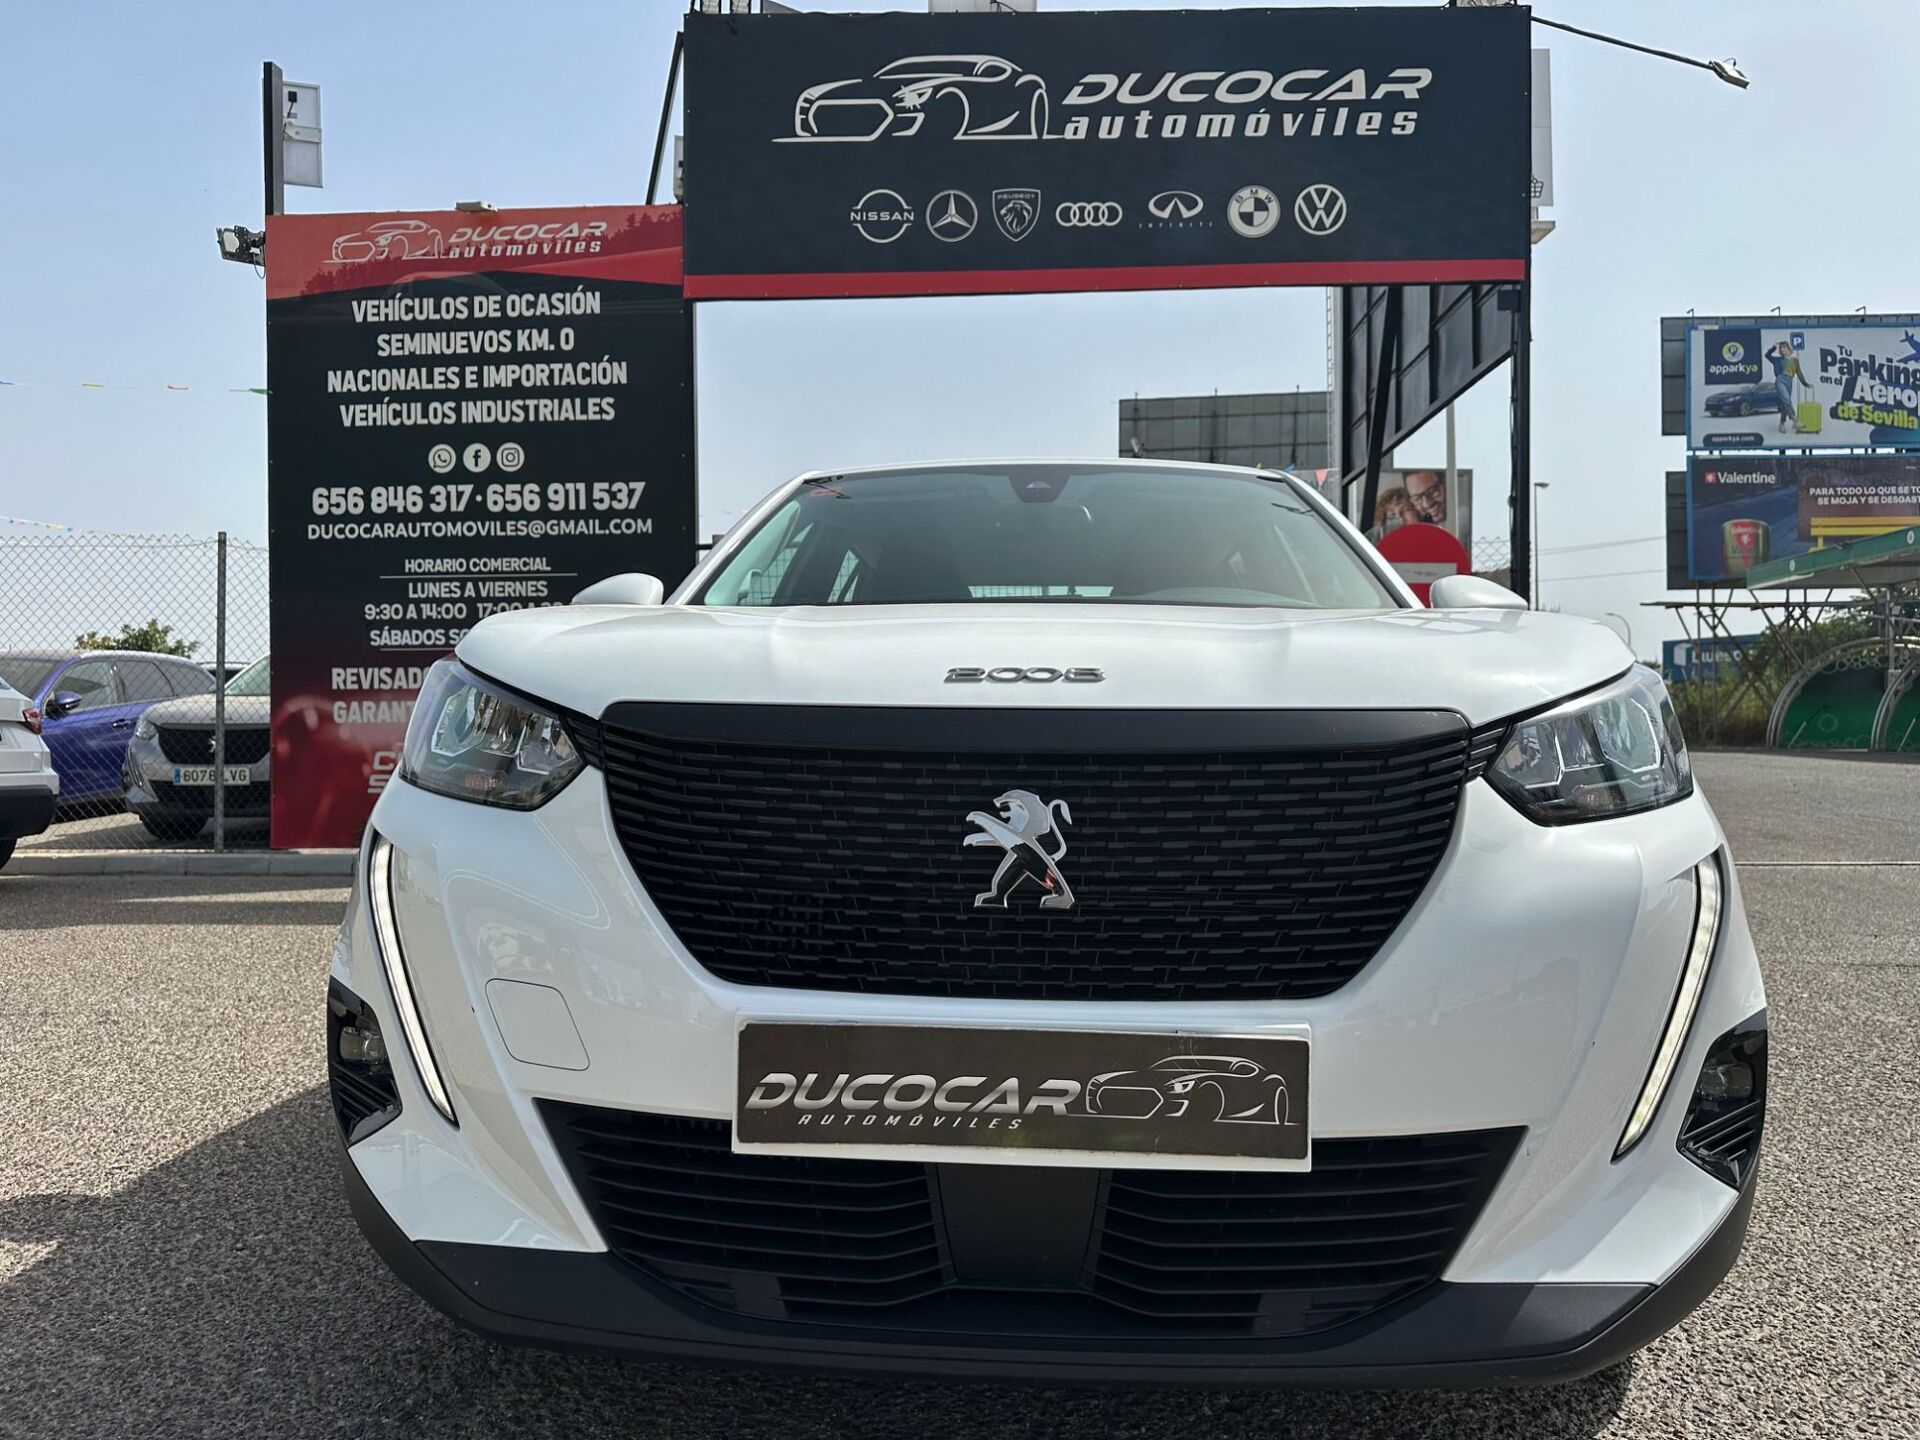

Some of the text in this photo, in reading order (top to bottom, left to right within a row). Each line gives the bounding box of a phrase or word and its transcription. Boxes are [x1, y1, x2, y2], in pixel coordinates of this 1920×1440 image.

[1061, 67, 1433, 105] DUCOCAR
[1064, 107, 1419, 140] automóviles
[850, 210, 914, 222] NISSAN
[448, 222, 608, 243] DUCOCAR
[352, 285, 601, 323] VEHÍCULOS DE OCASIÓN
[376, 329, 512, 357] SEMINUEVOS
[516, 328, 555, 352] KM.
[1837, 344, 1852, 357] Tu
[327, 355, 628, 393] NACIONALES E IMPORTACIÓN
[1709, 363, 1758, 375] apparkya
[1853, 376, 1920, 416] Aero
[340, 397, 616, 427] VEHÍCULOS INDUSTRIALES
[1837, 401, 1919, 429] de Sevilla
[1717, 471, 1777, 484] Valentine
[312, 486, 365, 516] 656
[370, 485, 424, 514] 846
[547, 482, 587, 511] 911
[592, 481, 646, 510] 537
[1809, 487, 1835, 496] PARA
[1836, 486, 1863, 495] TODO
[1864, 486, 1876, 495] LO
[1877, 486, 1897, 495] QUE
[1830, 496, 1859, 505] MOJA
[1860, 496, 1866, 504] Y
[1867, 495, 1879, 504] SE
[307, 518, 653, 540] DUCOCARAUTOMOVILES@GMAIL.COM
[404, 556, 552, 574] HORARIO COMERCIAL
[408, 580, 549, 599] LUNES A VIERNES
[364, 603, 403, 620] 9:30
[406, 603, 418, 620] A
[420, 602, 467, 619] 14:00
[370, 626, 446, 646] SÁBADOS
[331, 667, 430, 690] REVISAD
[944, 667, 1106, 684] 2008
[744, 1071, 1082, 1116] DUCOCAR
[797, 1113, 1023, 1130] AUTOMÓVILES
